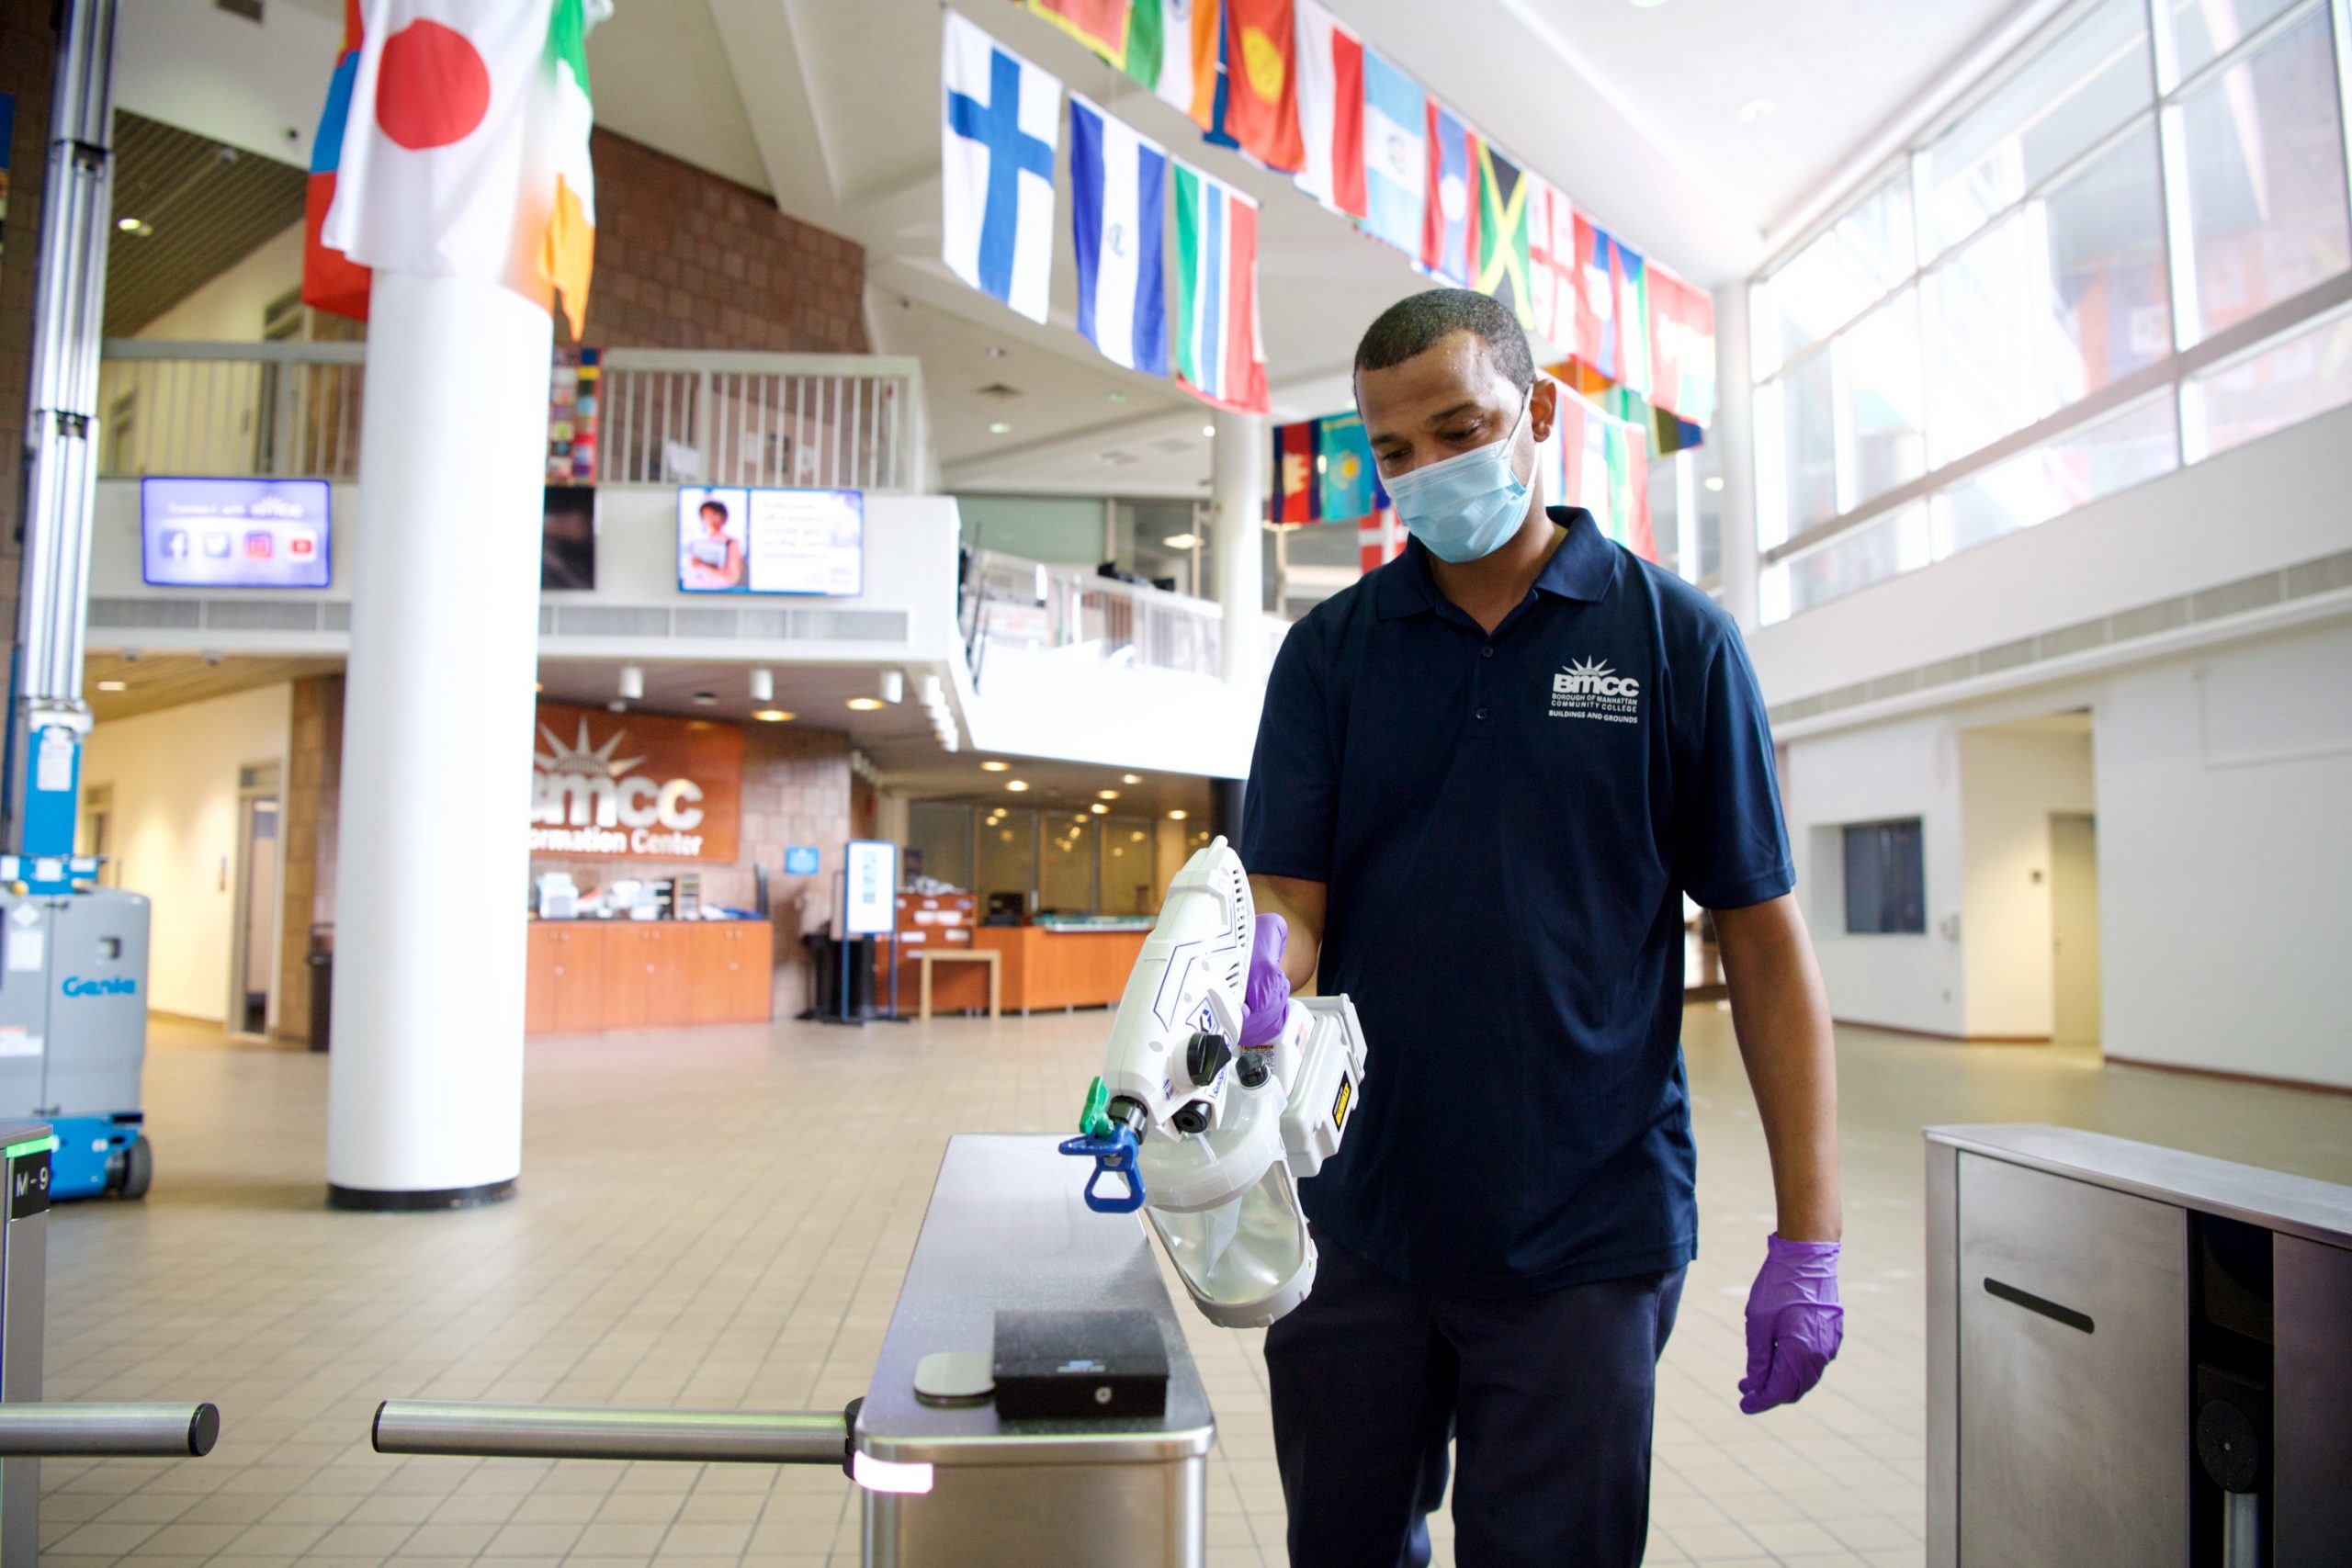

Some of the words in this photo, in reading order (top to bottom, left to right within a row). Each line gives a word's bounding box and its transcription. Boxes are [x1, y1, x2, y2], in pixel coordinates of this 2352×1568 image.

[1551, 700, 1600, 709] COMMUNITY
[1601, 704, 1637, 713] COLLEGE
[1552, 694, 1585, 702] BOROUGH
[1597, 695, 1637, 705] MANHATTAN
[1548, 709, 1586, 718] BUILDINGS
[1587, 712, 1602, 720] AND
[1603, 714, 1638, 724] GROUNDS
[531, 773, 704, 830] mcc
[529, 826, 628, 853] ormation
[631, 827, 704, 856] Center
[62, 976, 135, 998] Genie
[16, 1167, 49, 1198] M-9
